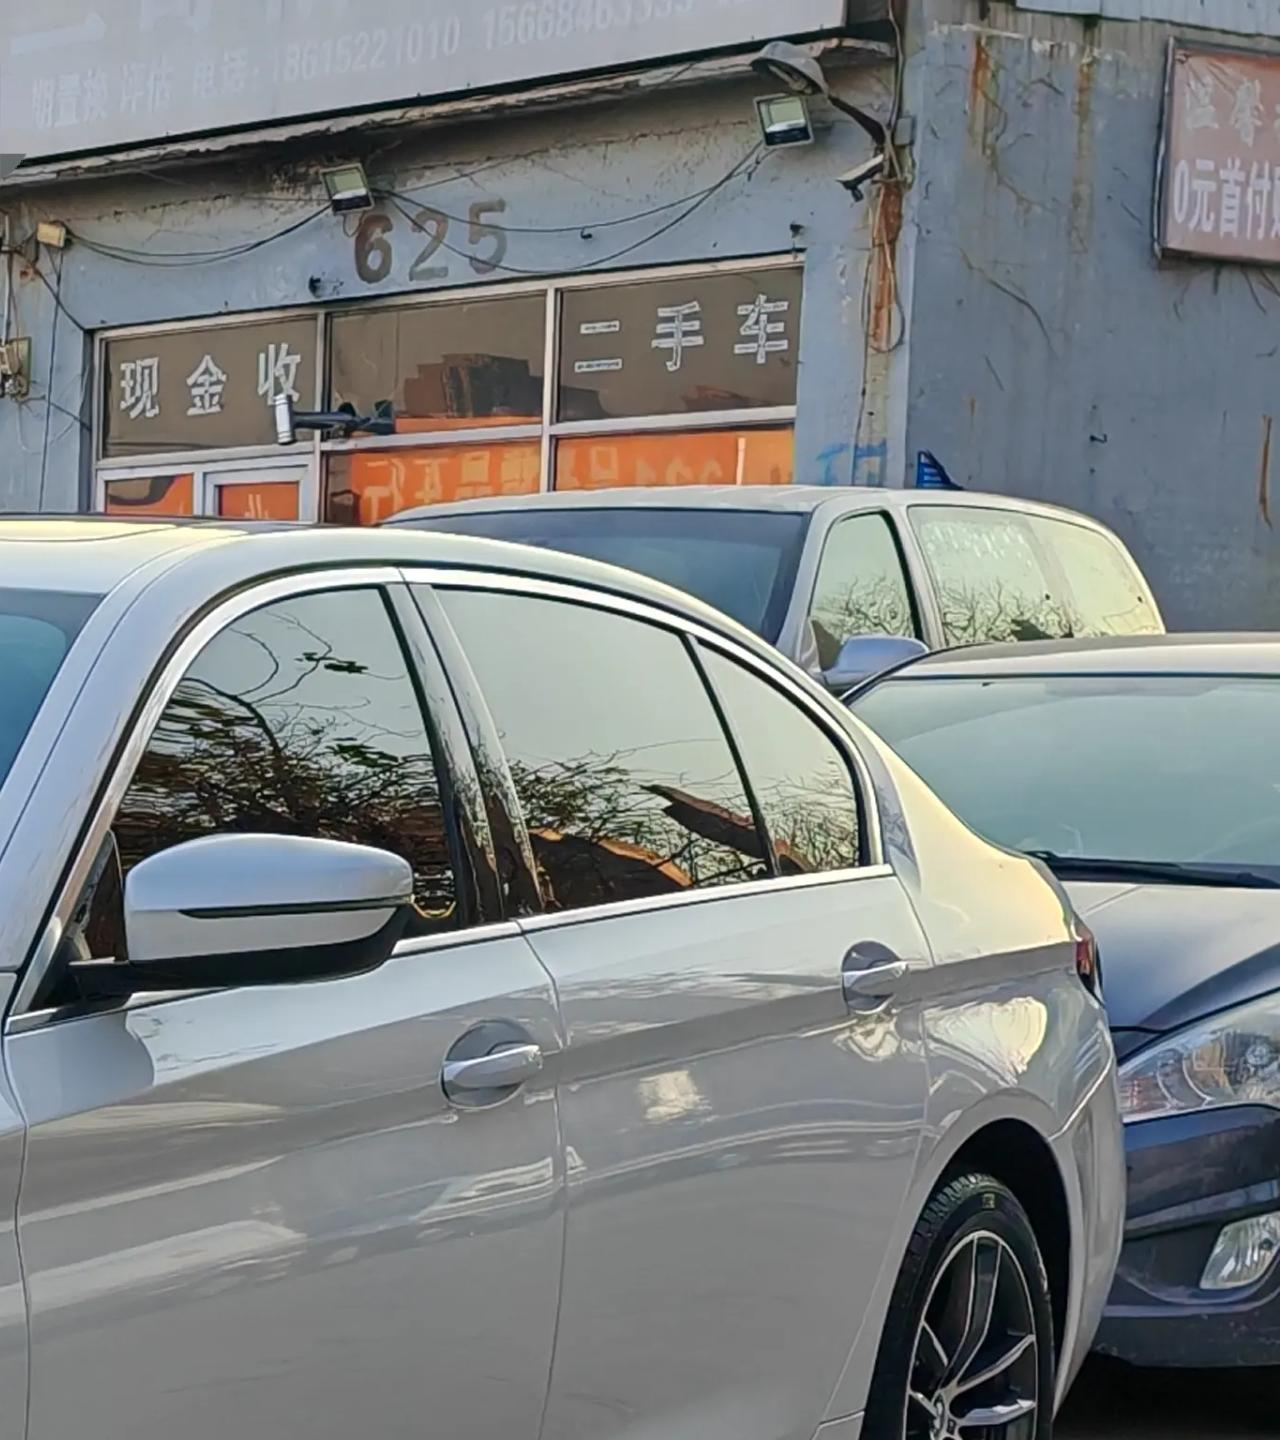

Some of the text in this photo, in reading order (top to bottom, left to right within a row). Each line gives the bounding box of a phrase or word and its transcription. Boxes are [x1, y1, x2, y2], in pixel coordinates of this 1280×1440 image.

[354, 198, 508, 284] 625
[118, 294, 788, 421] 现金收 二手车
